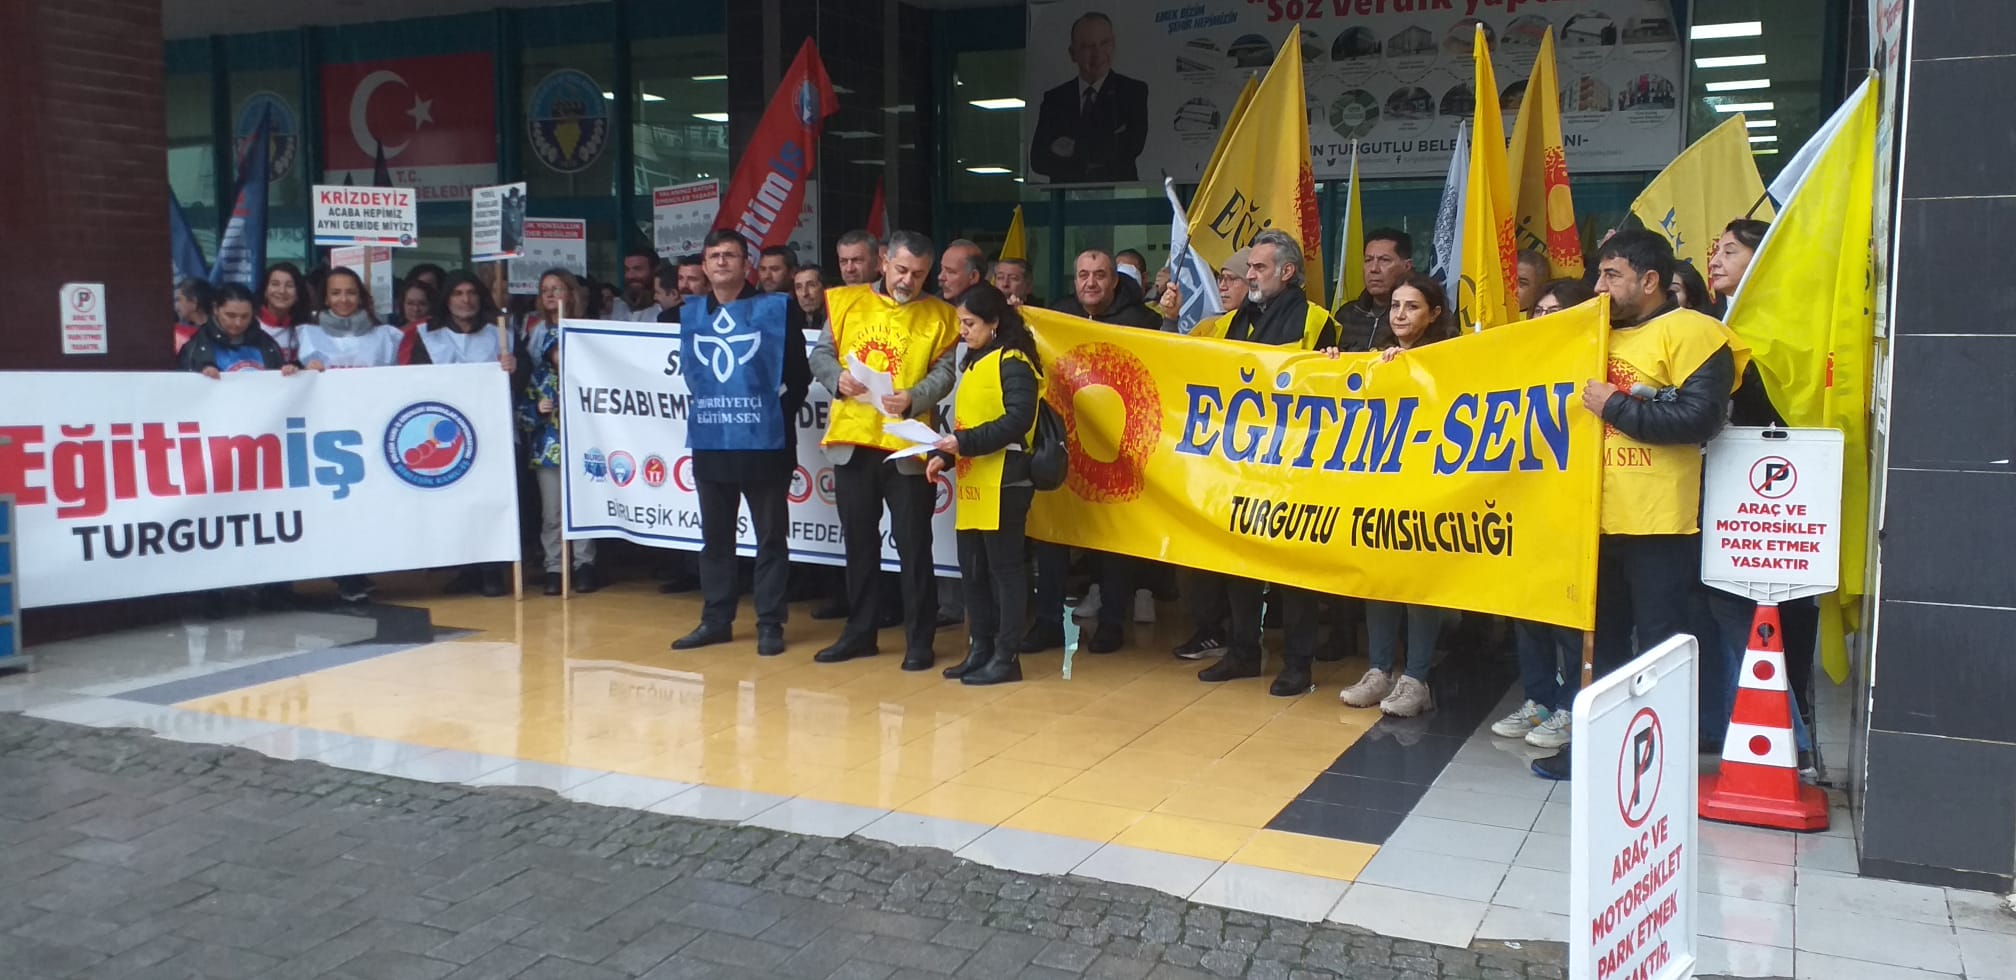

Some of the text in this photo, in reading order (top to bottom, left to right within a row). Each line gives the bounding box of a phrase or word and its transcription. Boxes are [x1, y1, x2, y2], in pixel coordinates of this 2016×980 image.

[320, 188, 408, 207] KRİZDEYİZ
[317, 219, 414, 232] AYNI GEMİDE MİYİZ?
[328, 207, 403, 219] ACABA HEPİMİZ
[578, 386, 656, 417] HESABI
[1174, 366, 1576, 476] EĞİTİM-SEN
[1616, 446, 1653, 467] SEN
[607, 499, 673, 528] BİRLEŞİK
[1229, 495, 1341, 545] TURGUTLU
[1737, 502, 1807, 517] ARAÇ VE
[72, 509, 304, 562] TURGUTLU
[1716, 519, 1828, 535] MOTORSİKLET
[1721, 537, 1820, 553] PARK ETMEK
[1730, 555, 1809, 570] YASAKTIR
[1612, 814, 1668, 885] ARAÇ VE
[1592, 843, 1683, 946] MOTORSİKLET
[1598, 888, 1678, 980] PARK ETMEK
